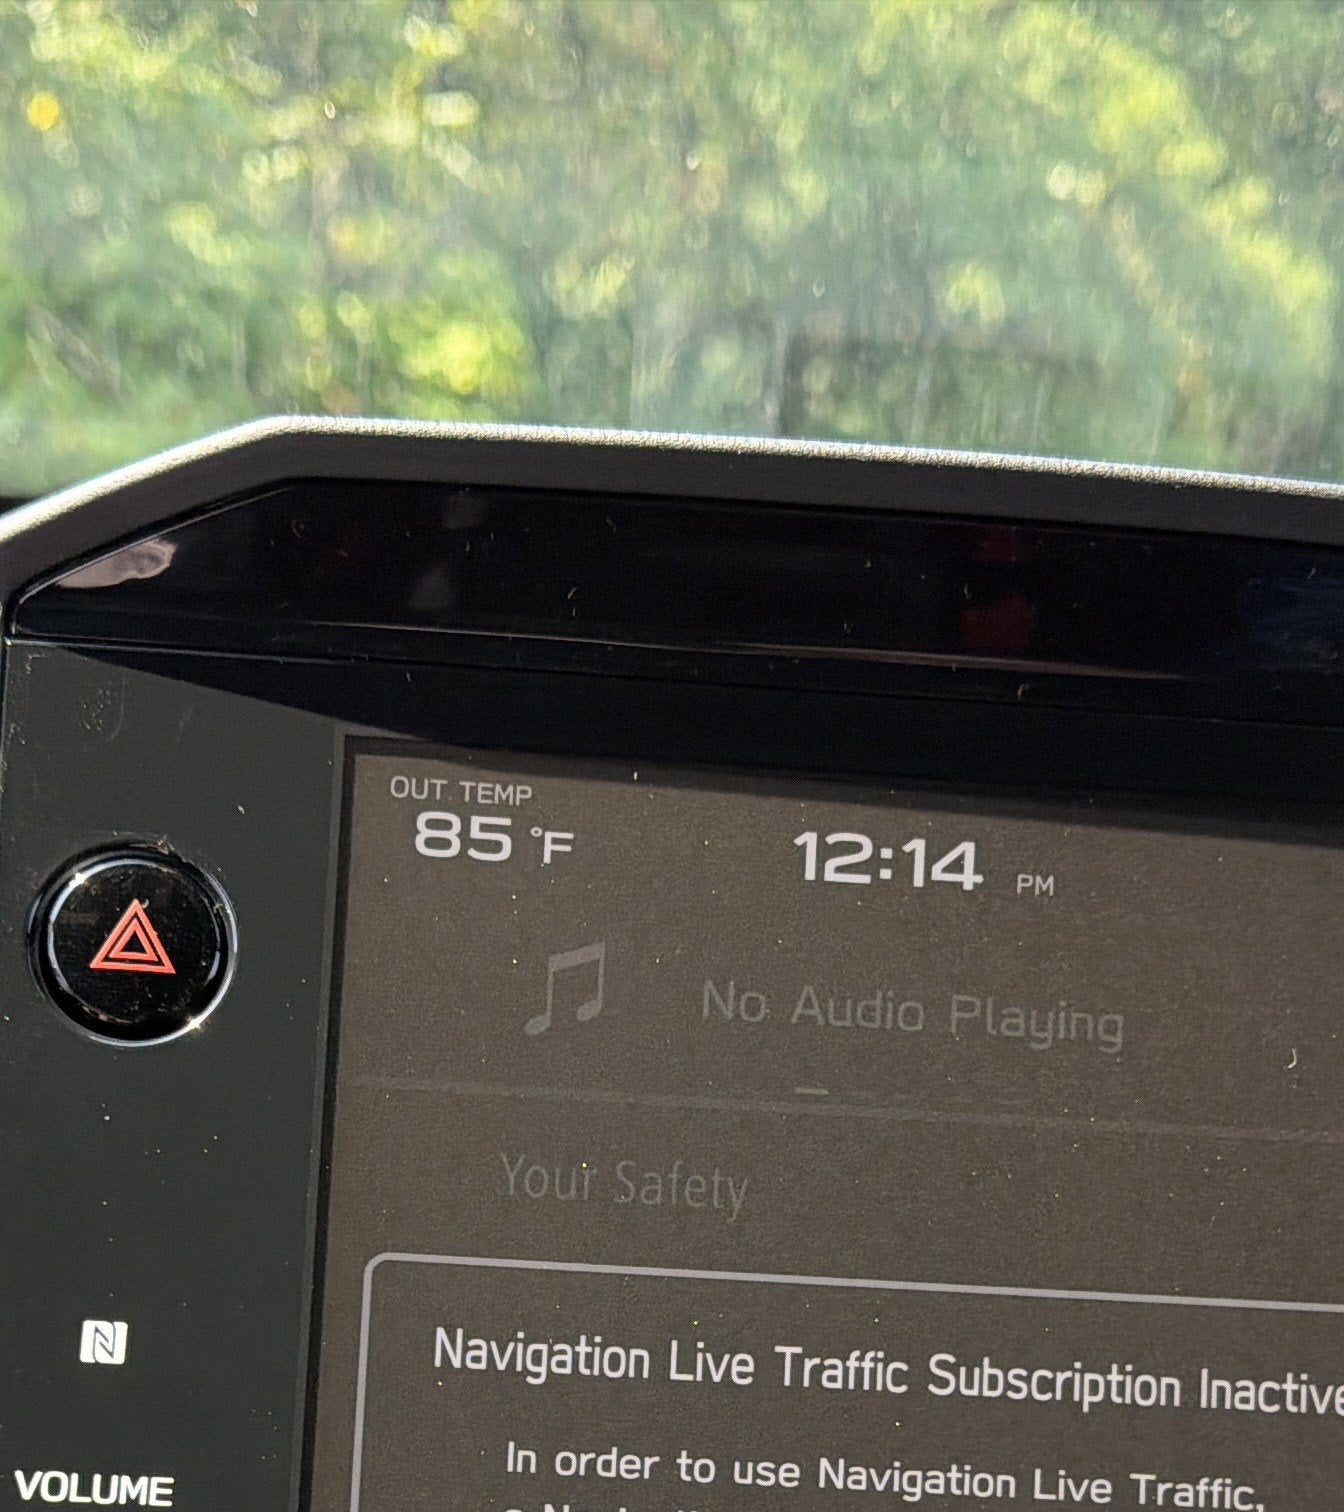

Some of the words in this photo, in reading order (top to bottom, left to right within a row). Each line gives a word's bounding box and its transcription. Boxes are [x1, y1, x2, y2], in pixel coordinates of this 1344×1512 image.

[389, 774, 449, 801] OUT
[458, 779, 533, 807] TEMP
[414, 809, 512, 862] 85
[530, 826, 575, 864] °F
[793, 830, 984, 891] 12:14
[1016, 873, 1055, 896] PM
[700, 978, 770, 1025] No
[788, 983, 928, 1034] Audio
[946, 993, 1126, 1055] Playing
[496, 1150, 599, 1203] Your
[613, 1158, 751, 1220] Safety
[434, 1326, 650, 1386] Navigation
[669, 1339, 755, 1386] Live
[773, 1345, 909, 1394] Traffic
[927, 1352, 1181, 1413] Subscription
[14, 1469, 175, 1508] VOLUME
[506, 1440, 537, 1474] In
[554, 1446, 662, 1480] order
[676, 1449, 716, 1485] to
[733, 1461, 801, 1488] use
[818, 1457, 1016, 1504] Navigation
[1033, 1468, 1113, 1504] Live
